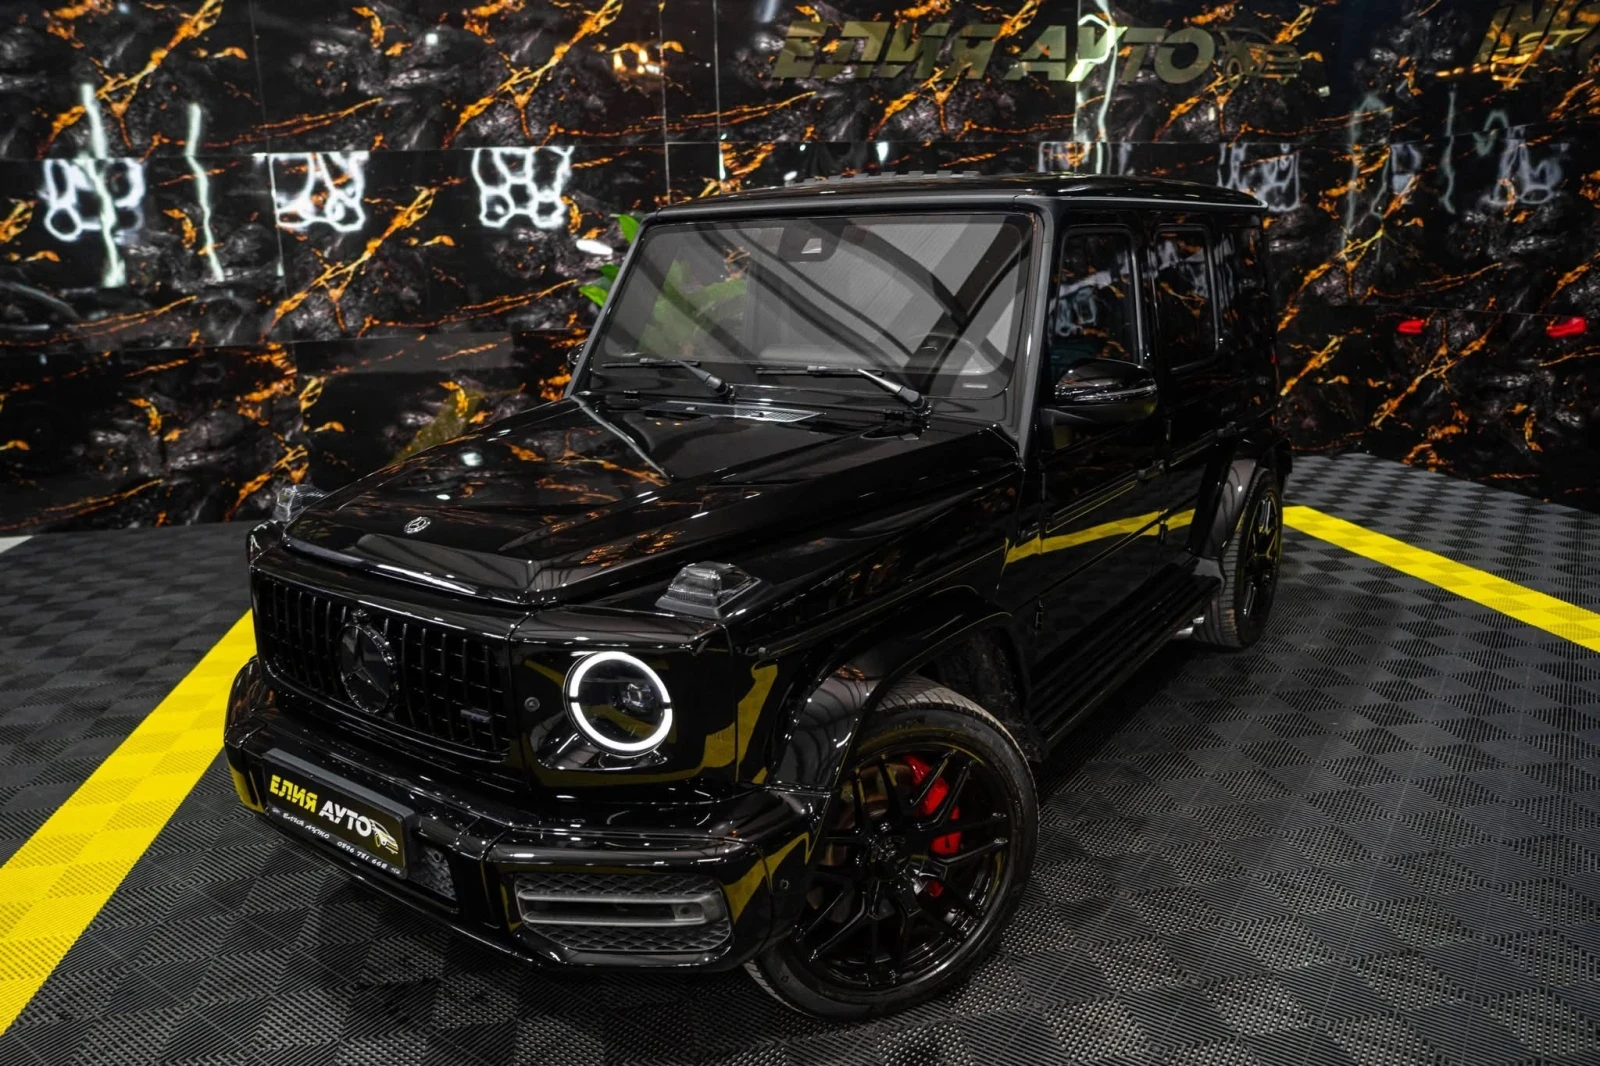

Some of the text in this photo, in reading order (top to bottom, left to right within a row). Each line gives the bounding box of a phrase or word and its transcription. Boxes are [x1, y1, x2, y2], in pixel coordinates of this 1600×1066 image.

[772, 20, 1216, 84] ЕЛИЯ АУТО
[270, 774, 372, 837] ЕЛИЯ АУТО
[337, 841, 355, 853] 0896
